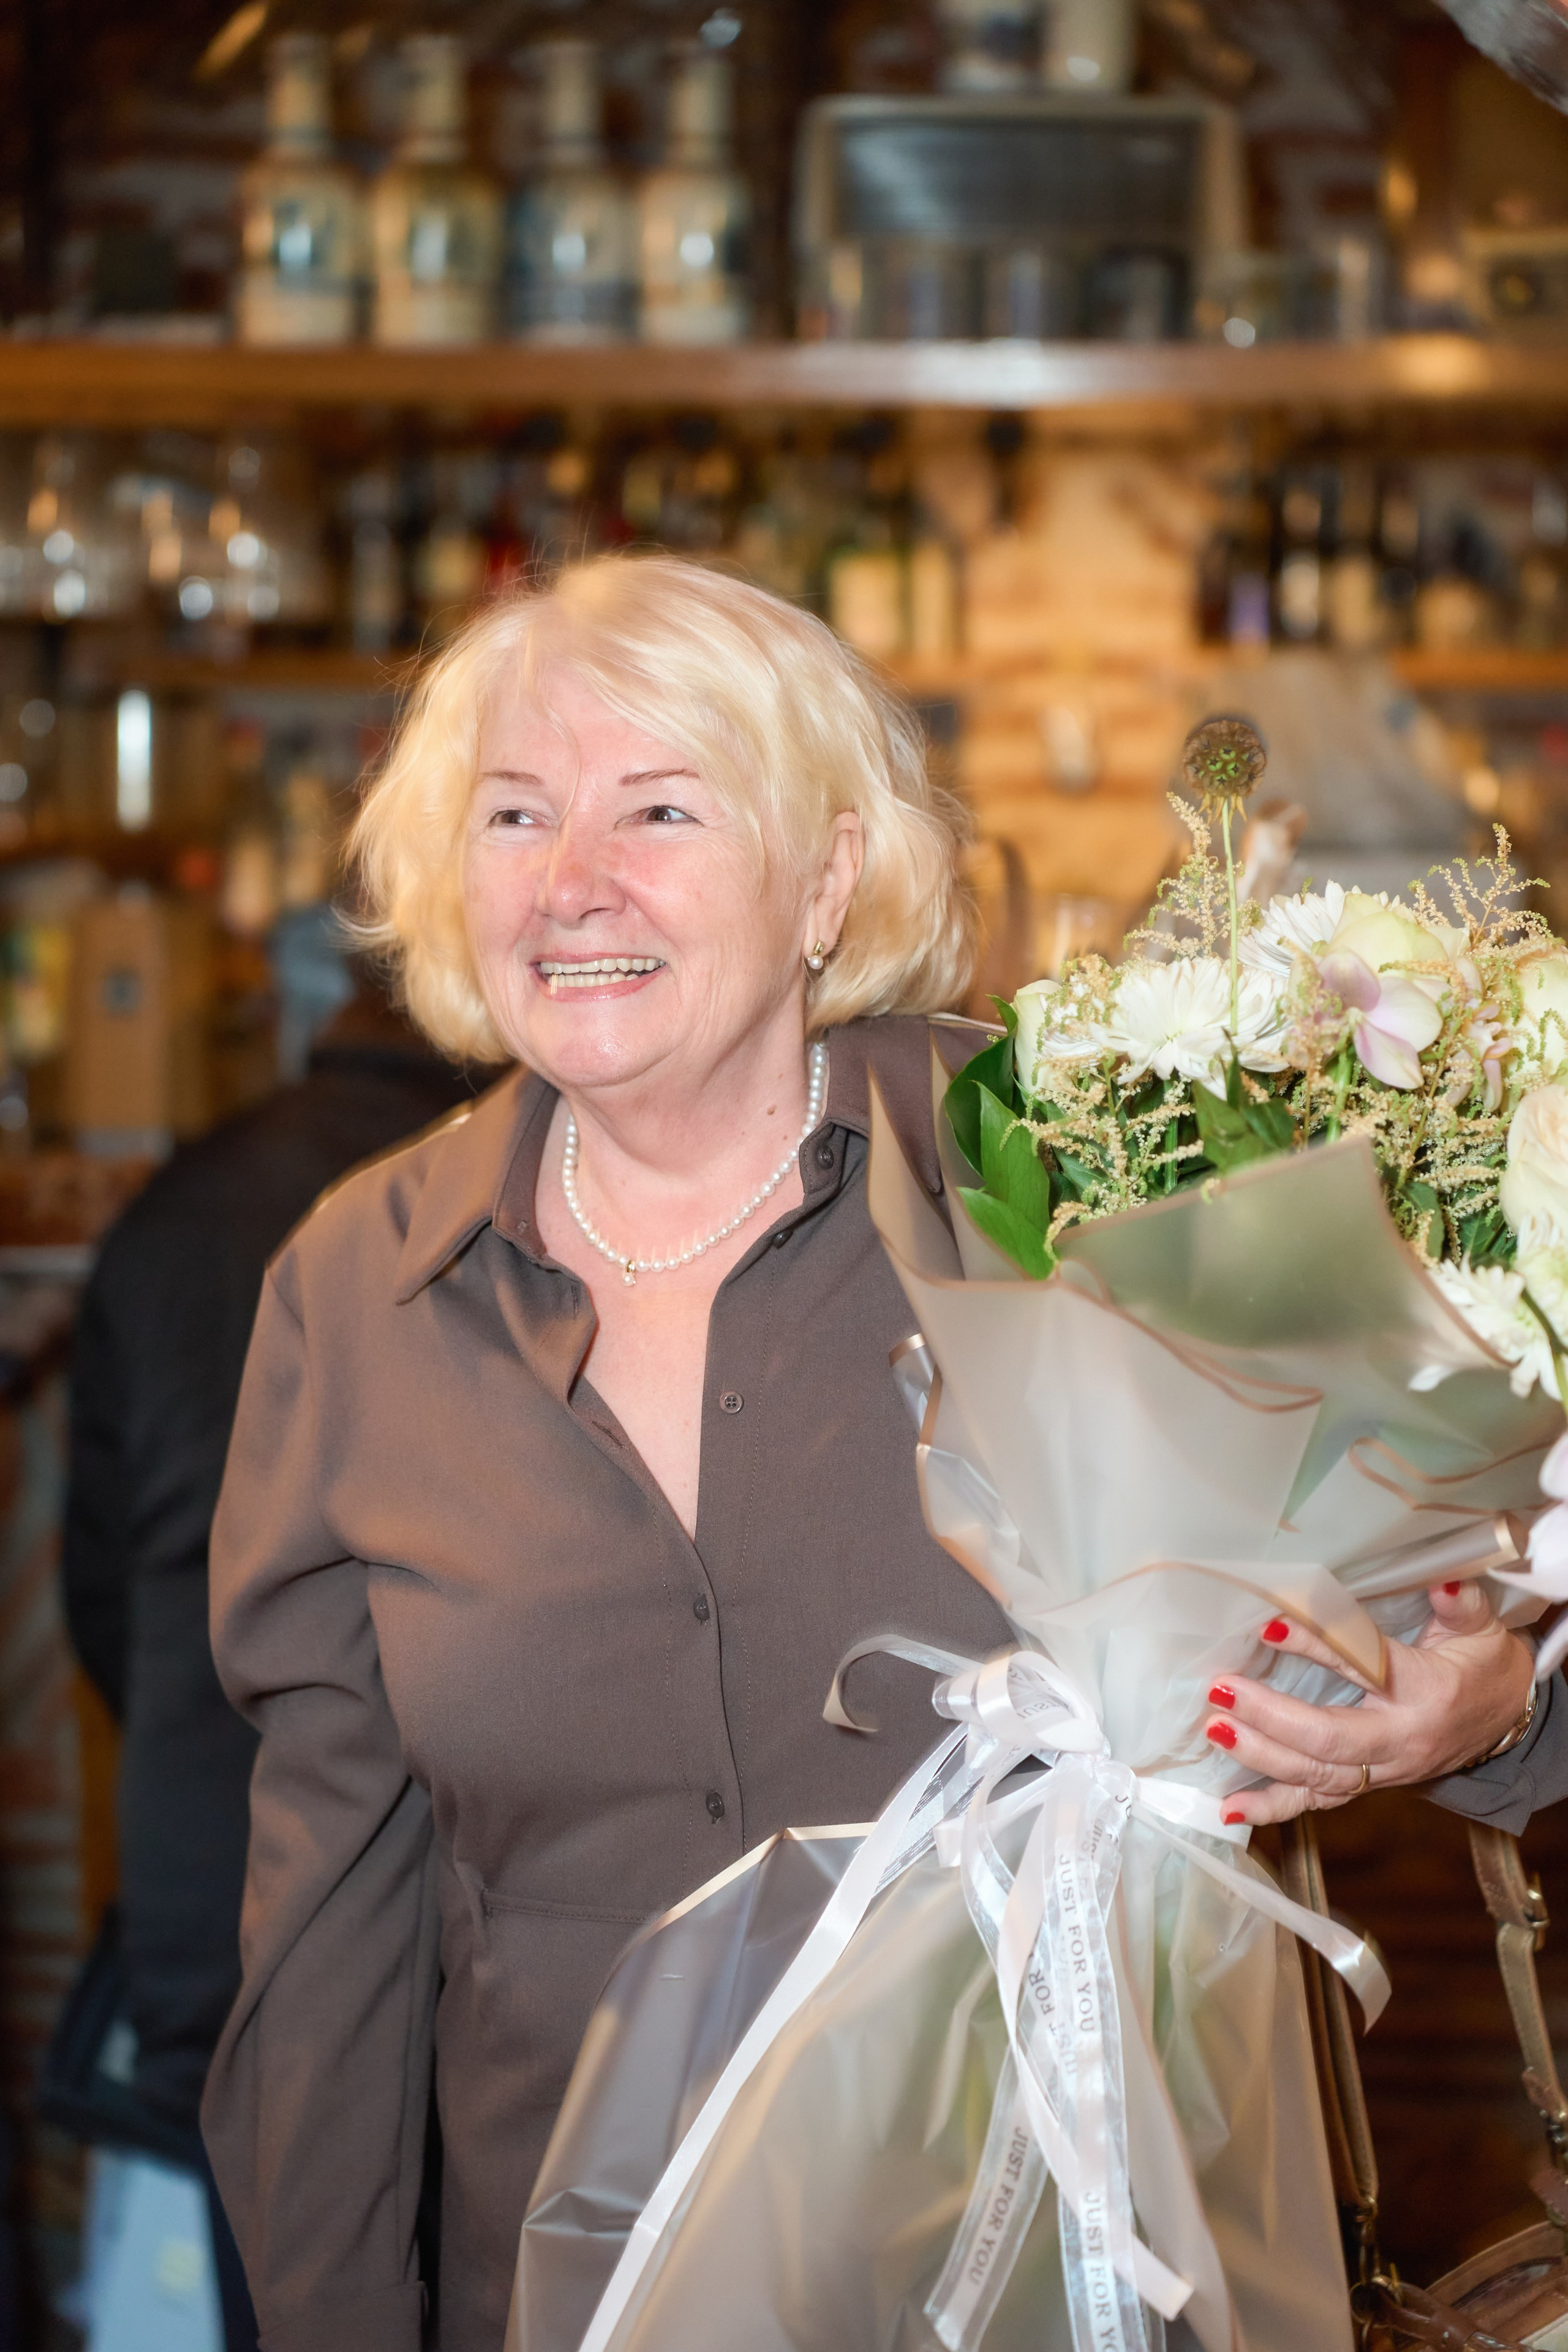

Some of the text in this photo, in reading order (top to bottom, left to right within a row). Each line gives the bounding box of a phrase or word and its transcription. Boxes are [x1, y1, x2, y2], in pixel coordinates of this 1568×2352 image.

[1060, 1854, 1077, 1915] JUST
[1068, 1925, 1088, 1975] FOR
[1028, 1967, 1056, 2015] FOR
[1077, 1982, 1095, 2032] YOU
[968, 2126, 1029, 2285] JUST FOR YOU
[1085, 2190, 1105, 2256] JUST
[1090, 2266, 1112, 2318] FOR
